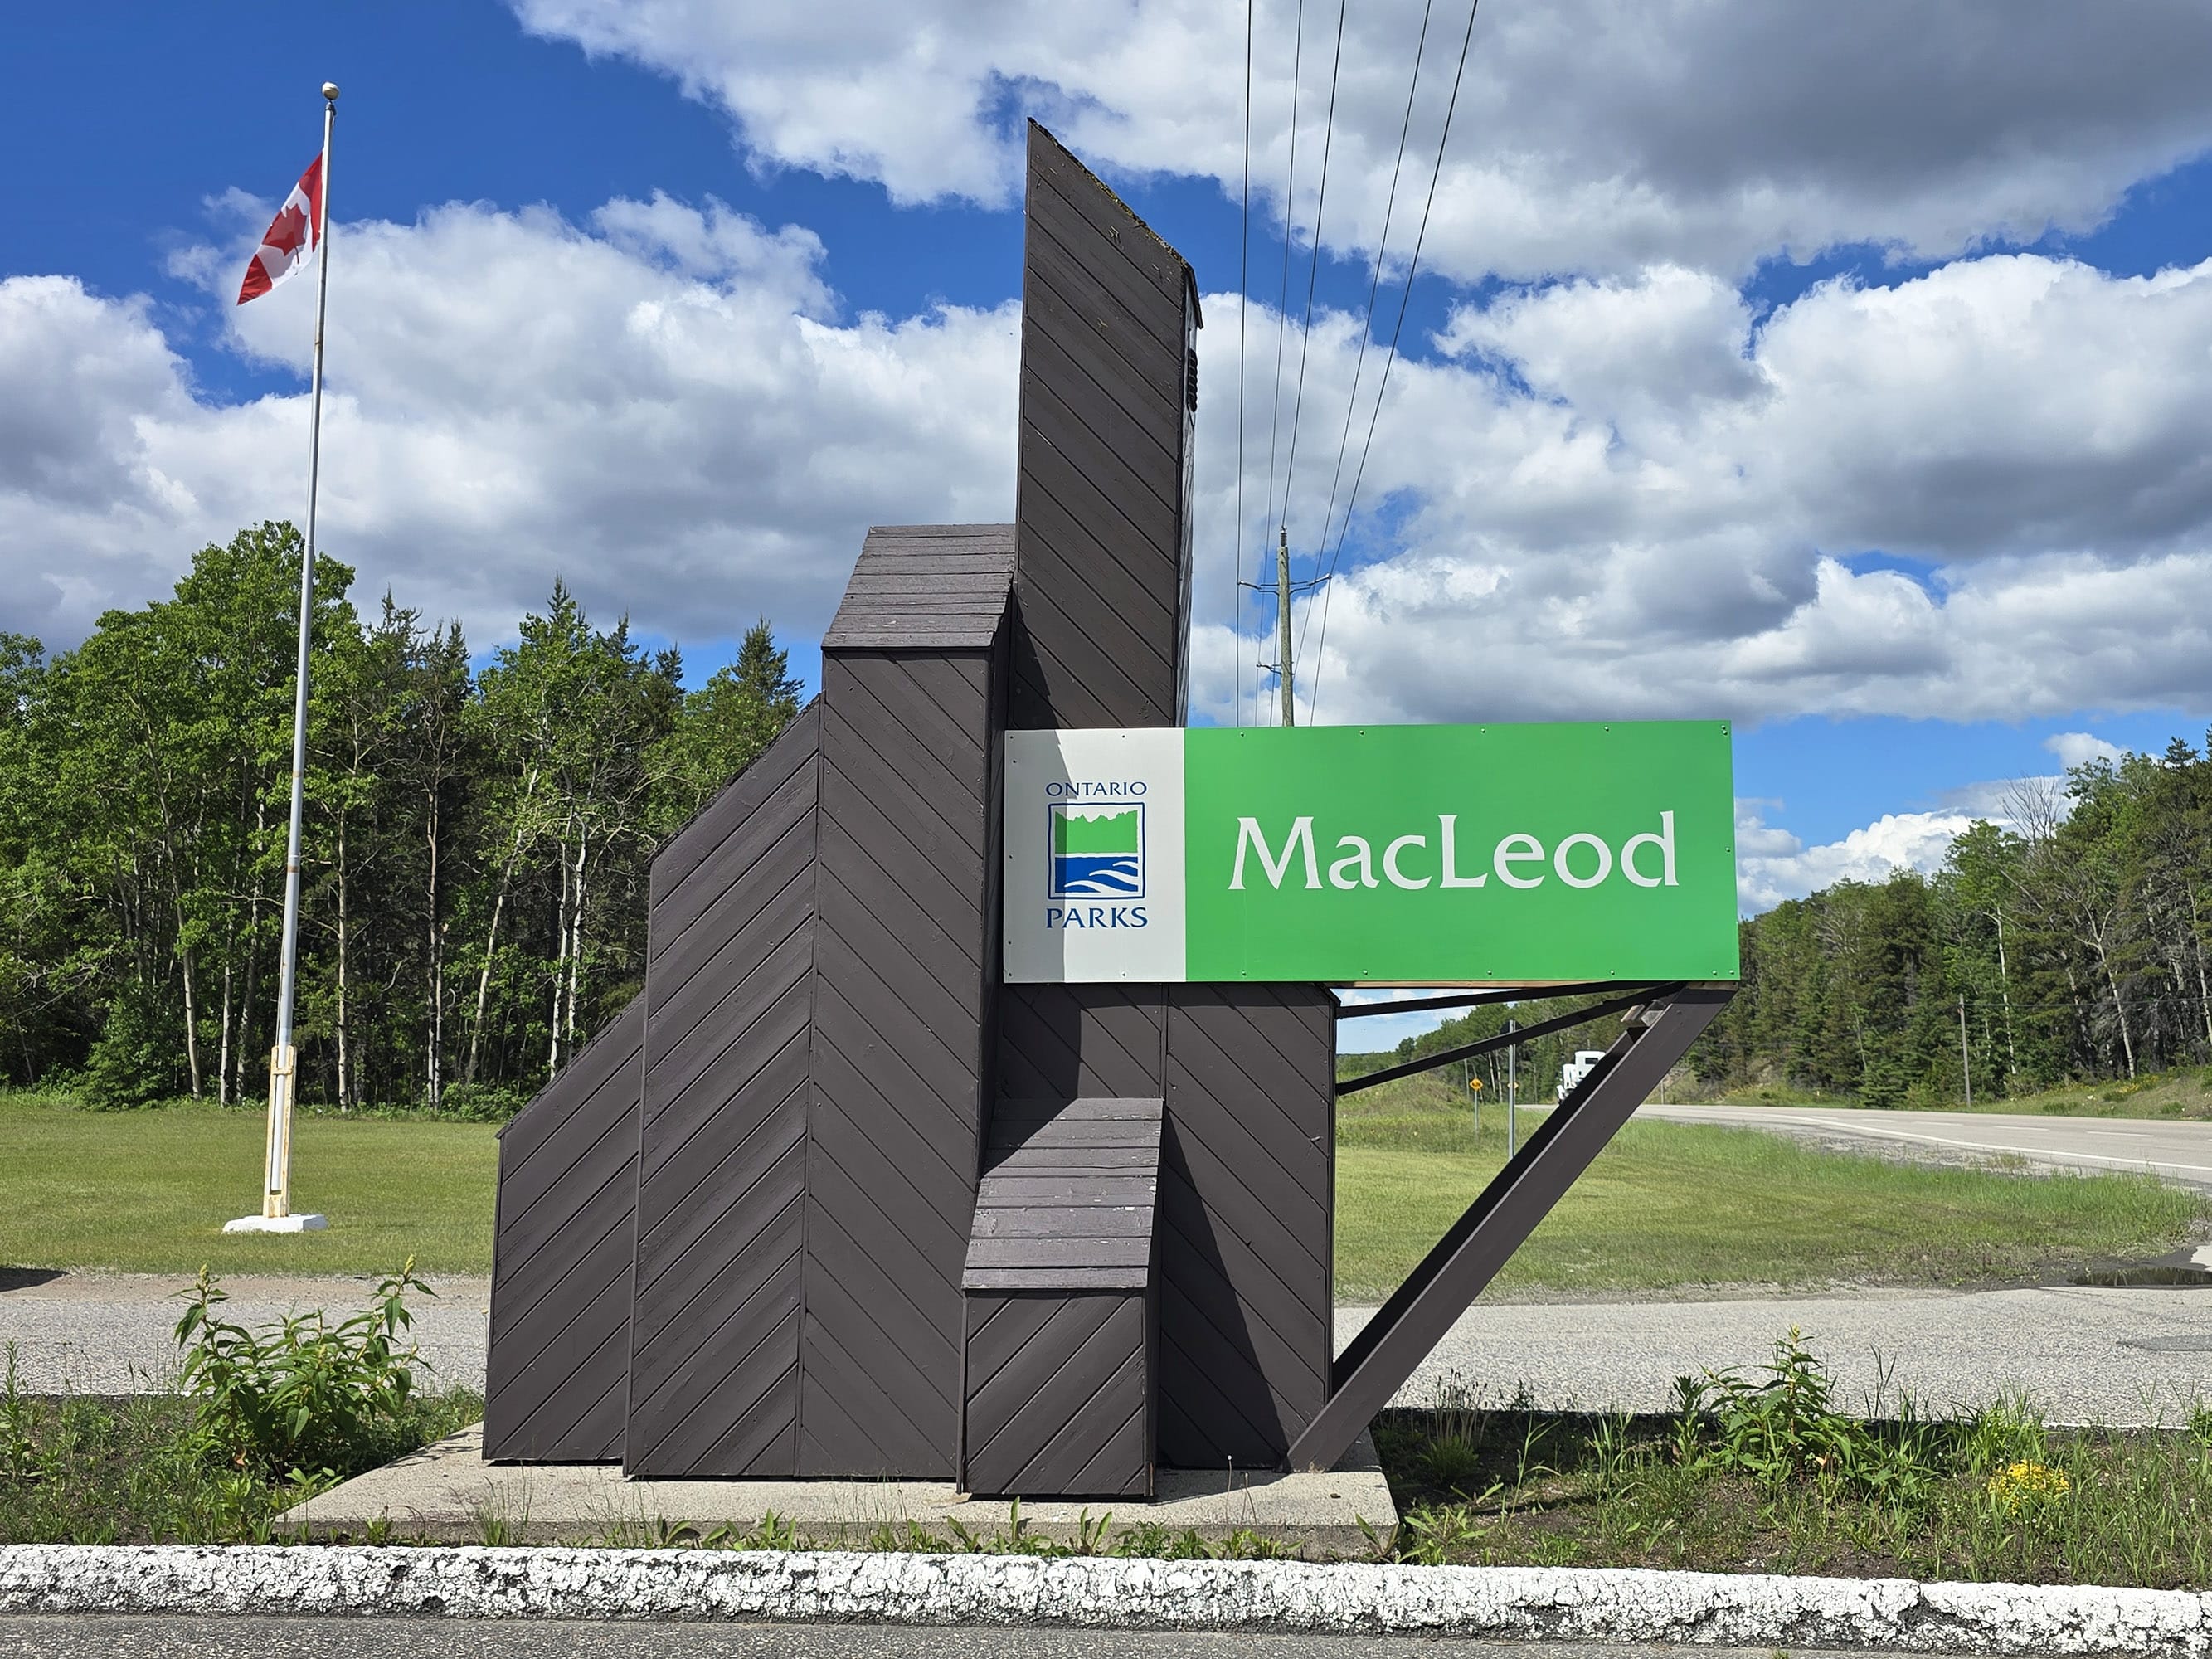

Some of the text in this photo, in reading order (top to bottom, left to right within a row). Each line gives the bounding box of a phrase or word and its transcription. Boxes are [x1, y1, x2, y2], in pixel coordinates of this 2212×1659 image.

[1046, 781, 1147, 796] ONTARIO
[1228, 810, 1680, 890] MacLeod
[1046, 907, 1148, 928] PARKS
